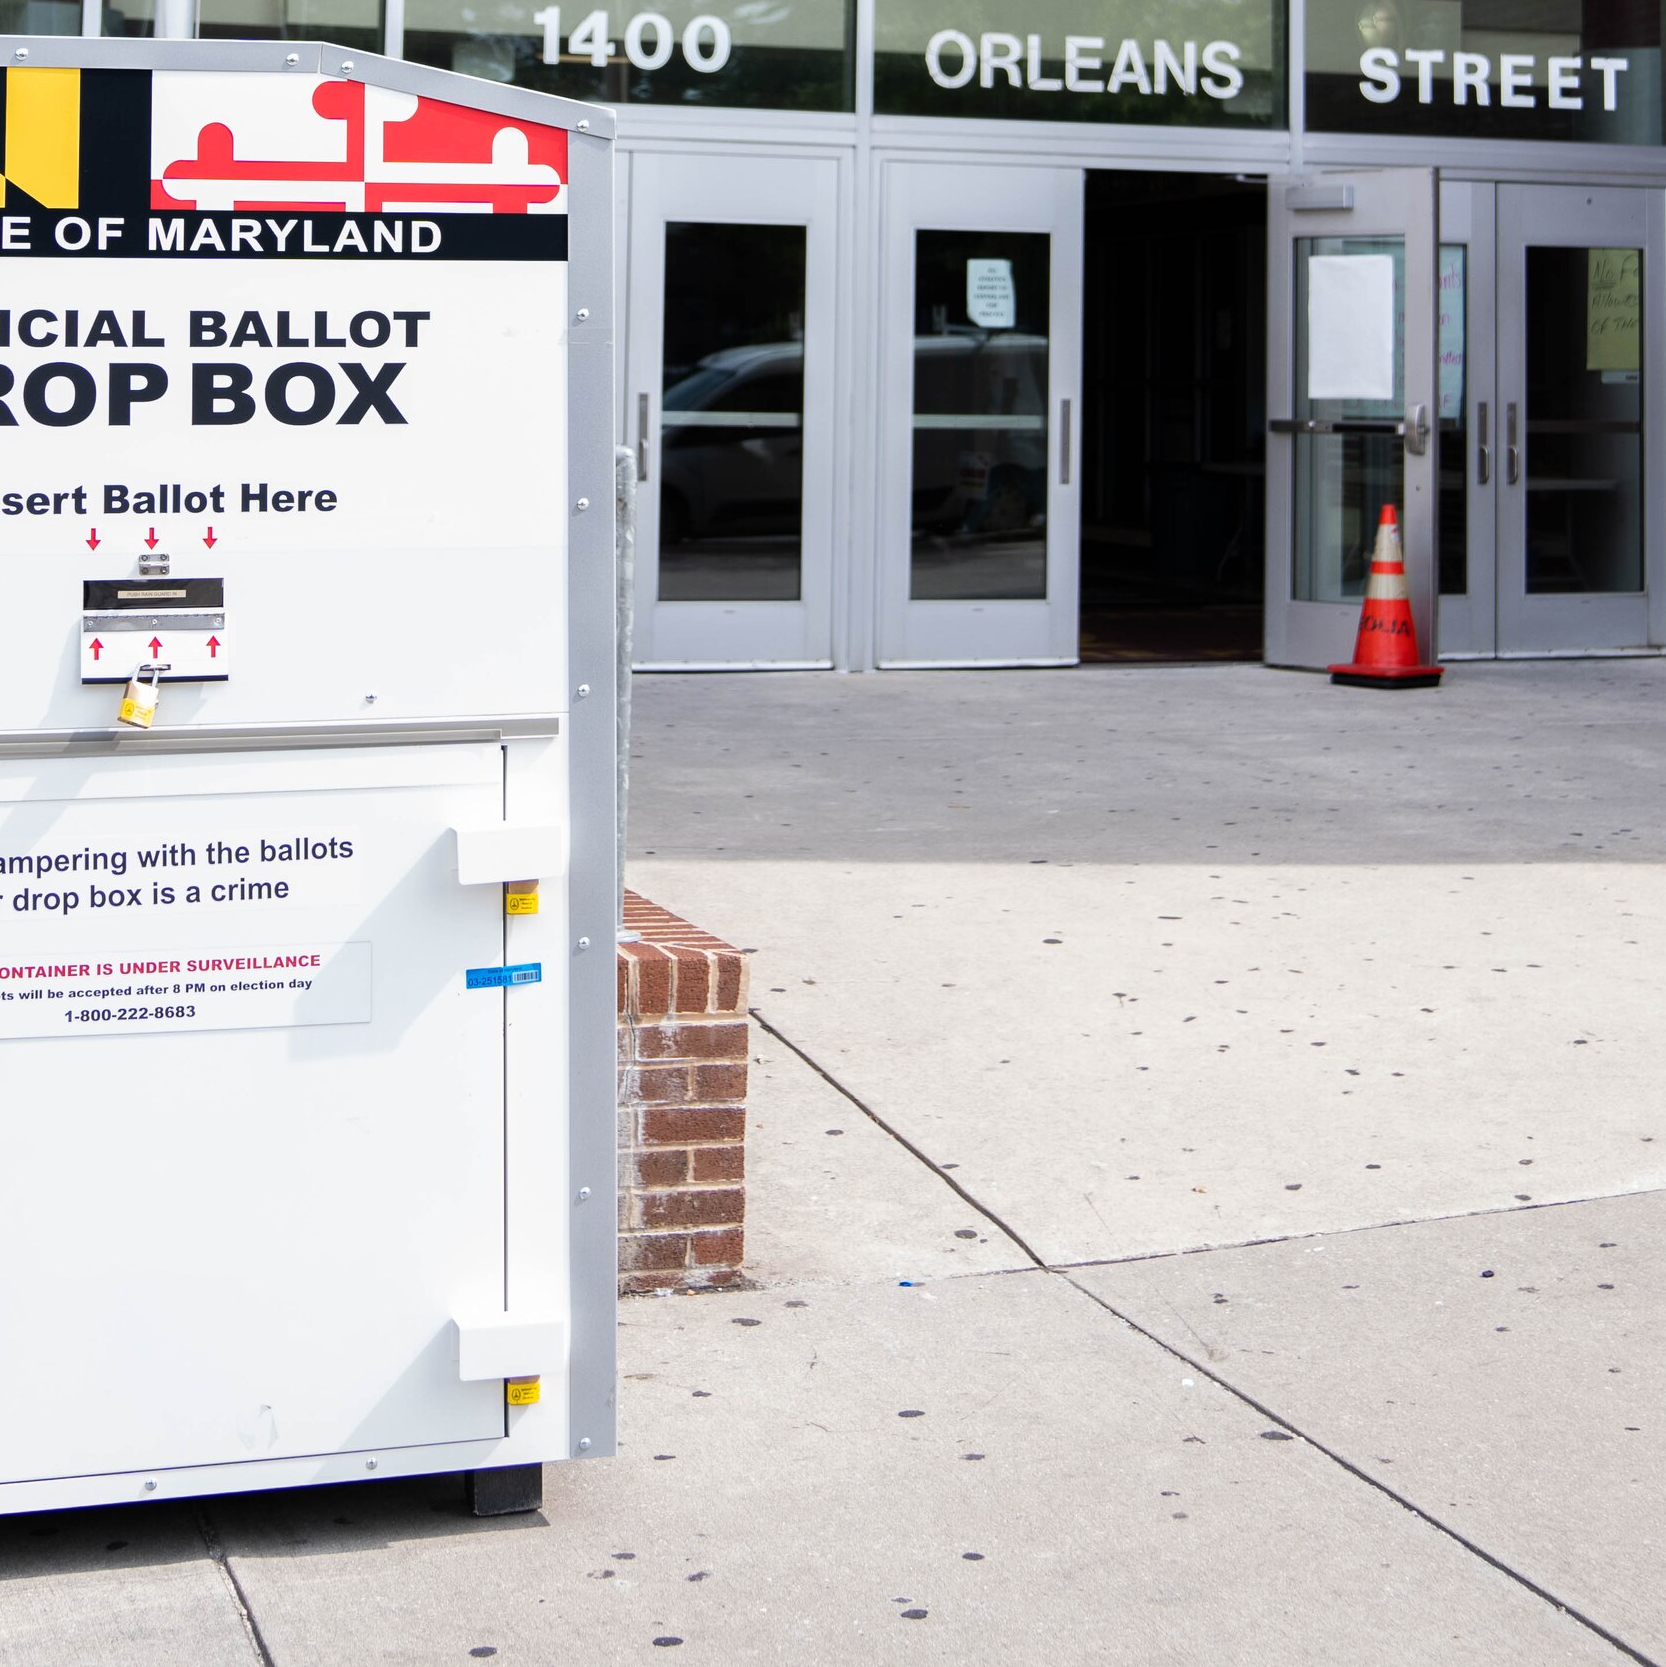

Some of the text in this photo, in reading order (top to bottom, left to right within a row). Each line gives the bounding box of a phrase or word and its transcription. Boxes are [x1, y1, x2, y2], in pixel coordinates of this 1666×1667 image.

[534, 7, 1630, 112] 1400 ORLEANS STREET
[55, 217, 124, 250] OF
[149, 218, 441, 252] MARYLAND
[190, 311, 430, 348] BALLOT
[192, 362, 408, 425] BOX
[104, 484, 224, 513] Ballot
[242, 484, 337, 512] Here
[138, 843, 195, 867] with
[206, 842, 249, 864] the
[261, 837, 353, 861] ballots
[13, 888, 79, 915] drop
[91, 885, 142, 907] box
[154, 882, 175, 904] is
[186, 886, 200, 903] a
[212, 878, 288, 901] crime
[97, 964, 112, 975] IS
[120, 961, 180, 974] UNDER
[187, 955, 320, 971] SURVEILLANCE
[19, 990, 42, 999] will
[48, 990, 63, 998] be
[69, 987, 131, 998] accepted
[137, 986, 168, 995] after
[173, 984, 180, 993] 8
[186, 983, 205, 992] PM
[231, 981, 284, 990] election
[289, 979, 312, 990] day
[468, 975, 512, 987] 03-251581
[65, 1006, 195, 1022] 1-800-222-8683
